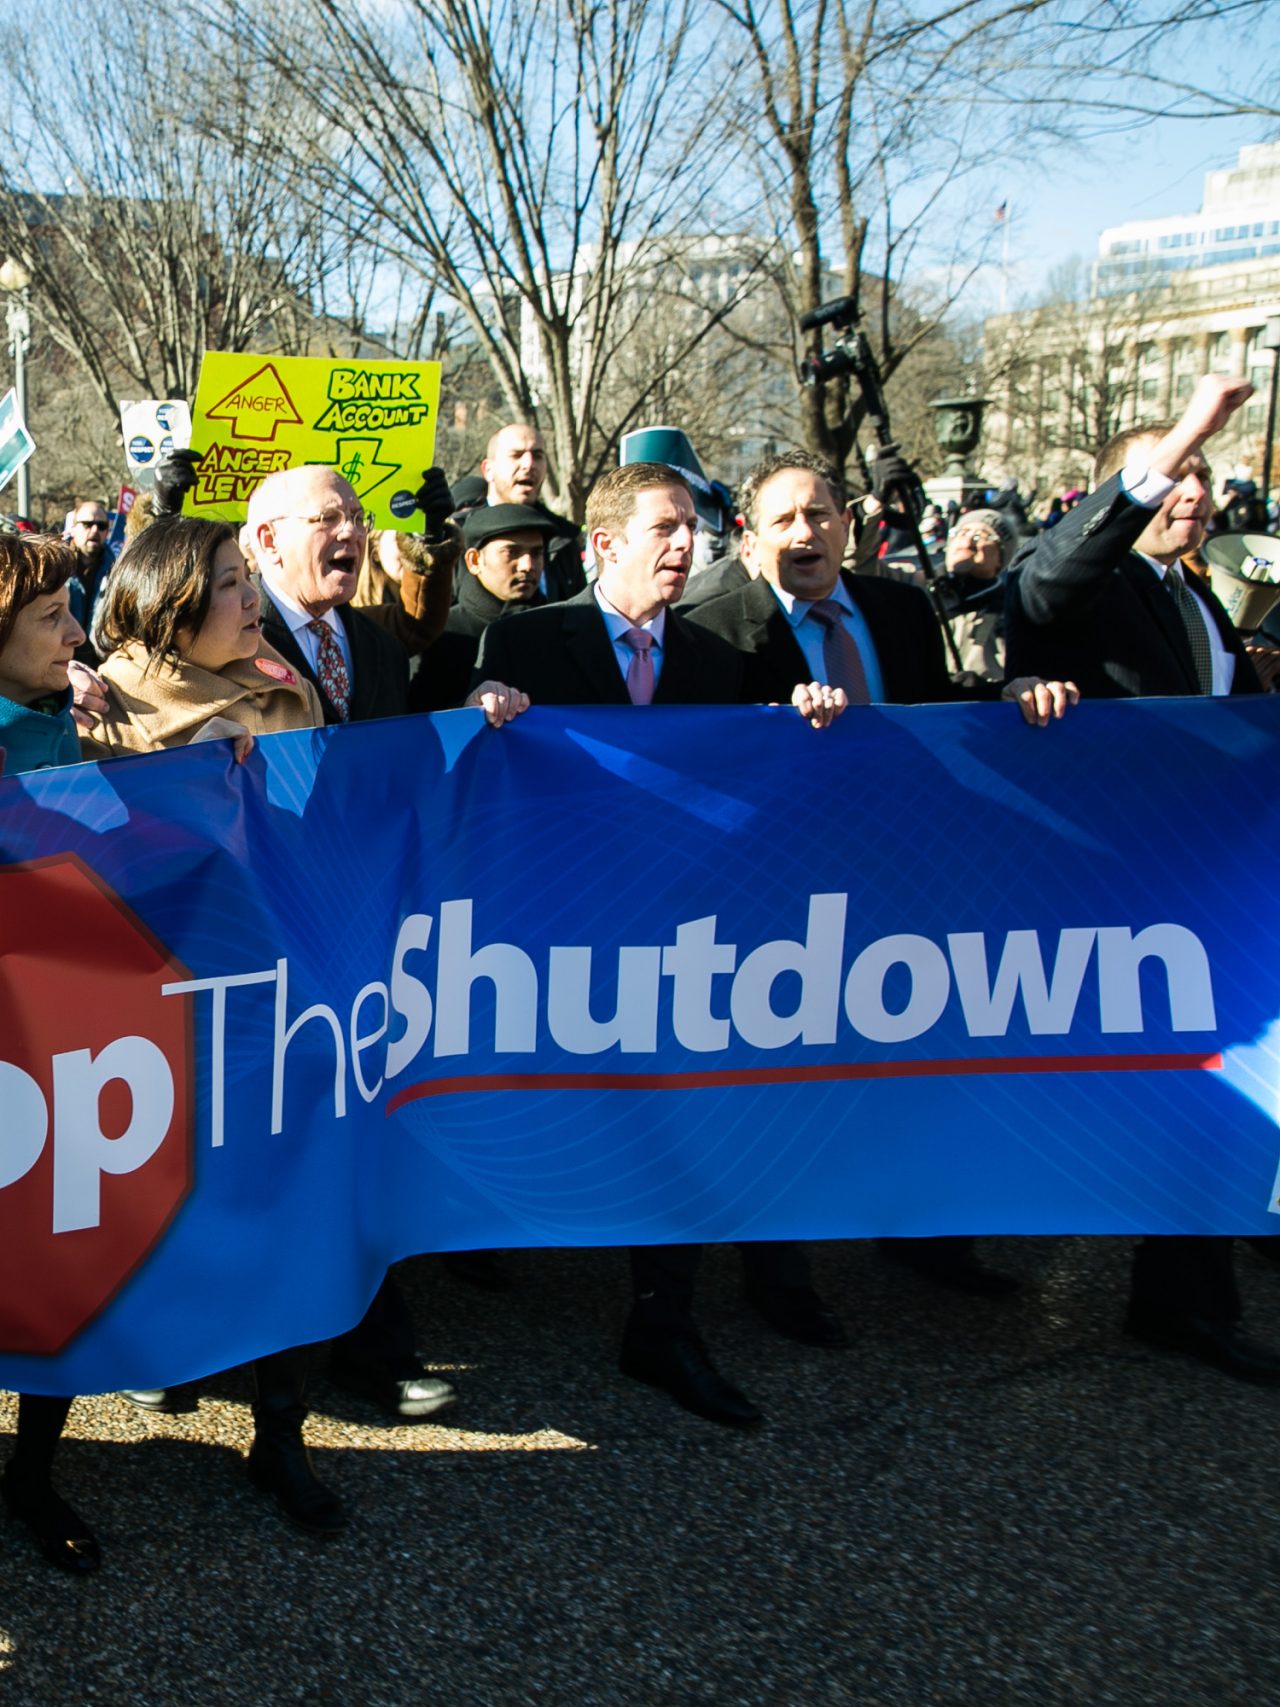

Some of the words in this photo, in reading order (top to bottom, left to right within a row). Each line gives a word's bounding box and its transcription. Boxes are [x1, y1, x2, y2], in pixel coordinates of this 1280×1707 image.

[327, 368, 422, 402] BANK
[225, 393, 287, 414] ANGER
[313, 400, 429, 433] ACCOUNT
[196, 441, 292, 474] ANGER
[193, 473, 267, 506] LEV
